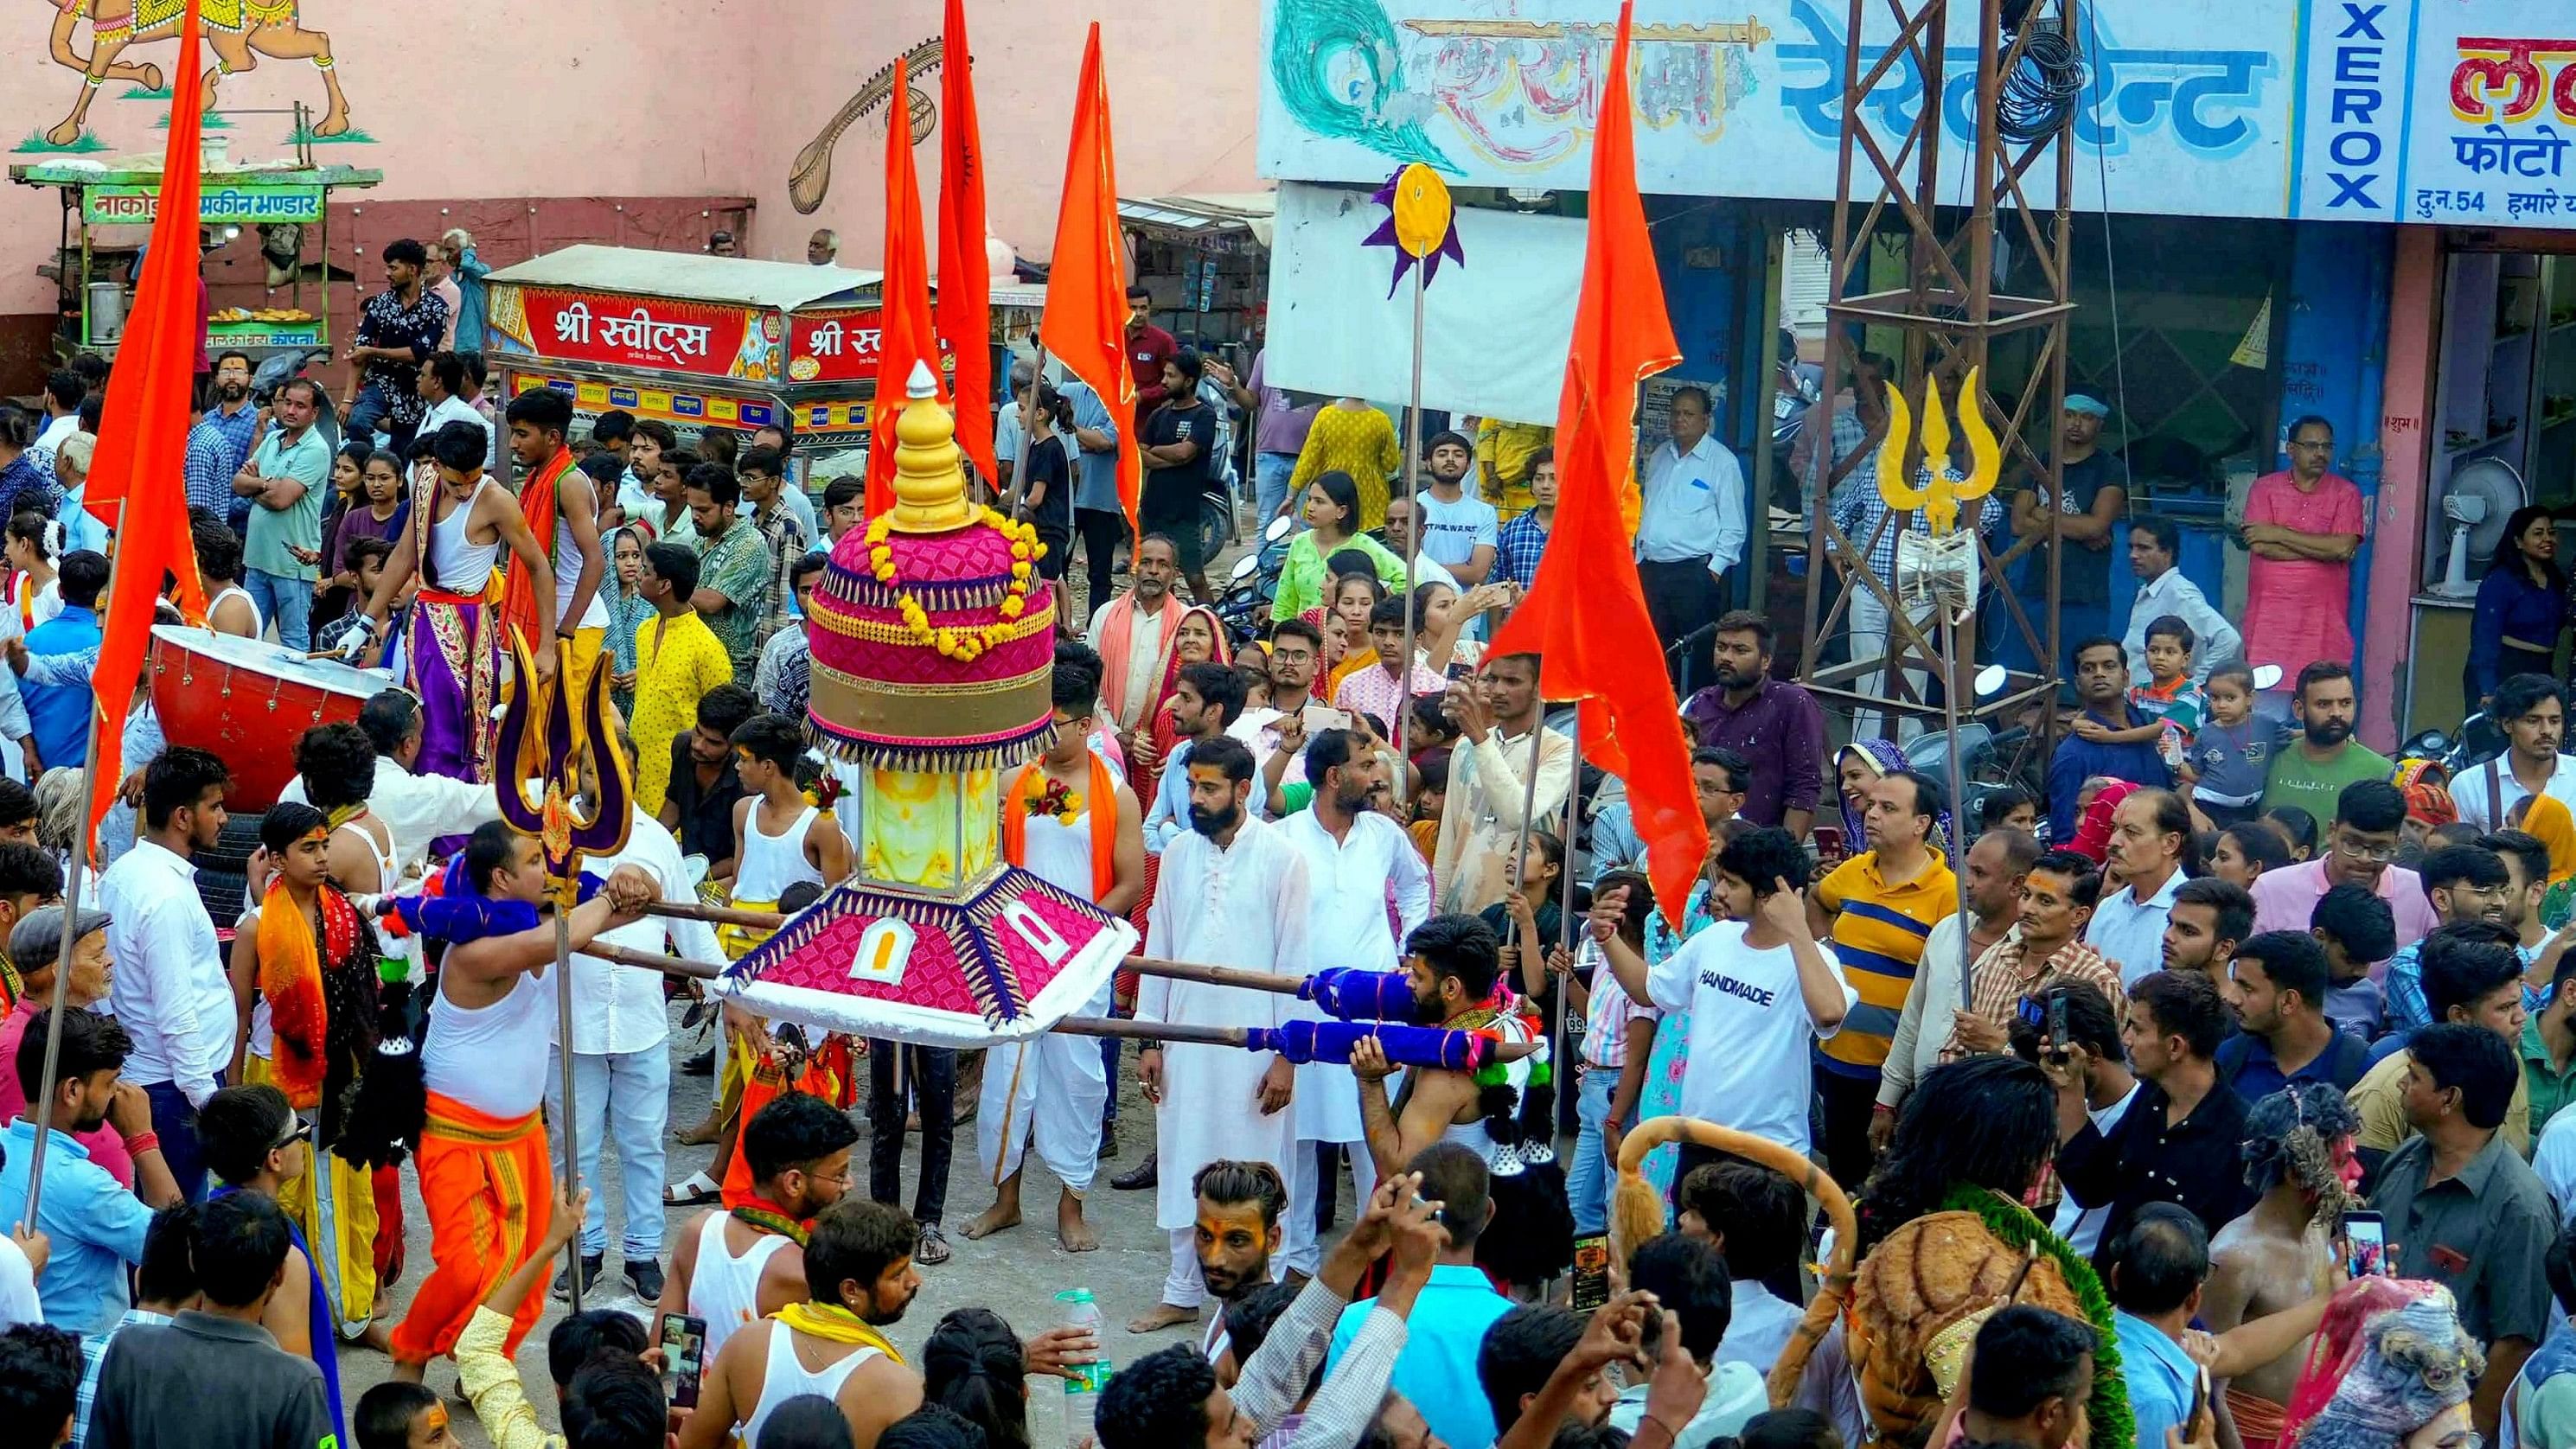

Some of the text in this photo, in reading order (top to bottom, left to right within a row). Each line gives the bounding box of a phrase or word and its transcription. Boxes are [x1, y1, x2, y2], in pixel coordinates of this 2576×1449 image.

[1775, 0, 2271, 149] रेस्टरेन्ट
[2326, 3, 2387, 209] XEROX
[2451, 124, 2573, 177] फोटो
[200, 189, 253, 215] मकीन
[2507, 188, 2560, 220] हमारे
[555, 302, 712, 365] श्री स्वीट्स
[809, 321, 845, 356] श्री
[1700, 969, 1774, 1006] HANDMADE
